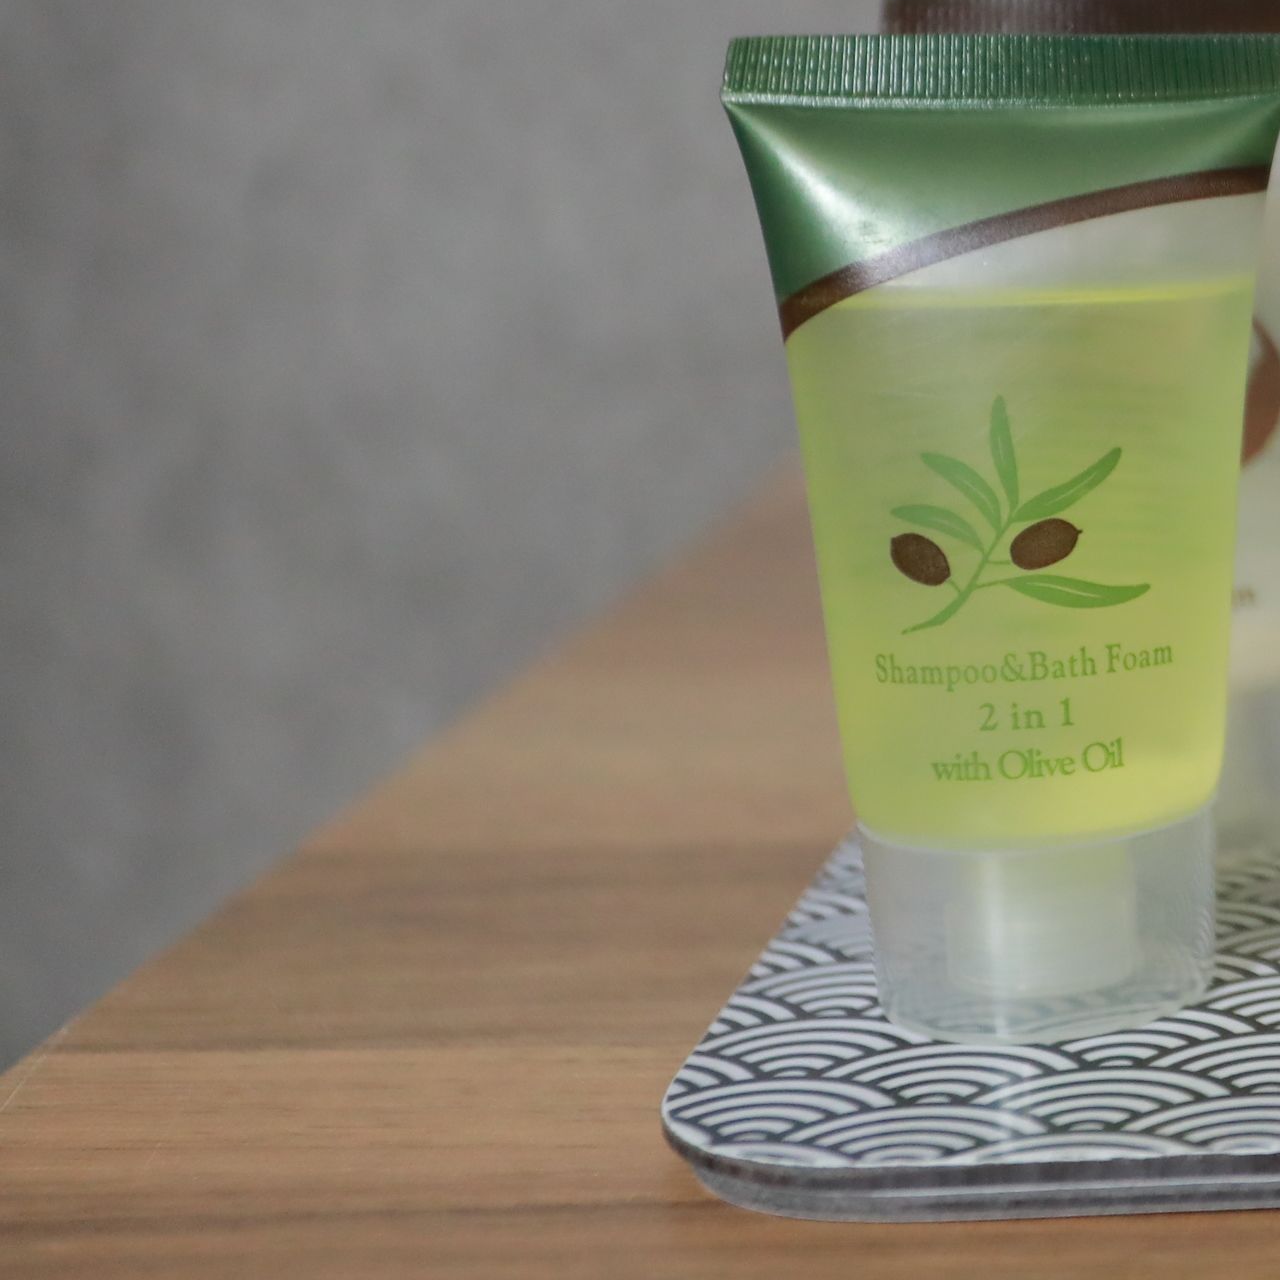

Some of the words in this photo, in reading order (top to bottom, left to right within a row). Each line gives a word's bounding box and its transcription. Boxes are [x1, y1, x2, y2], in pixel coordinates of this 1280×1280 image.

[874, 645, 1098, 693] Shampoo&Bath
[1105, 642, 1174, 674] Foam
[978, 702, 999, 732] 2
[1010, 702, 1047, 731] in
[1059, 697, 1075, 727] 1
[930, 750, 994, 782] with
[998, 748, 1076, 782] Olive
[1081, 736, 1126, 773] Oil
